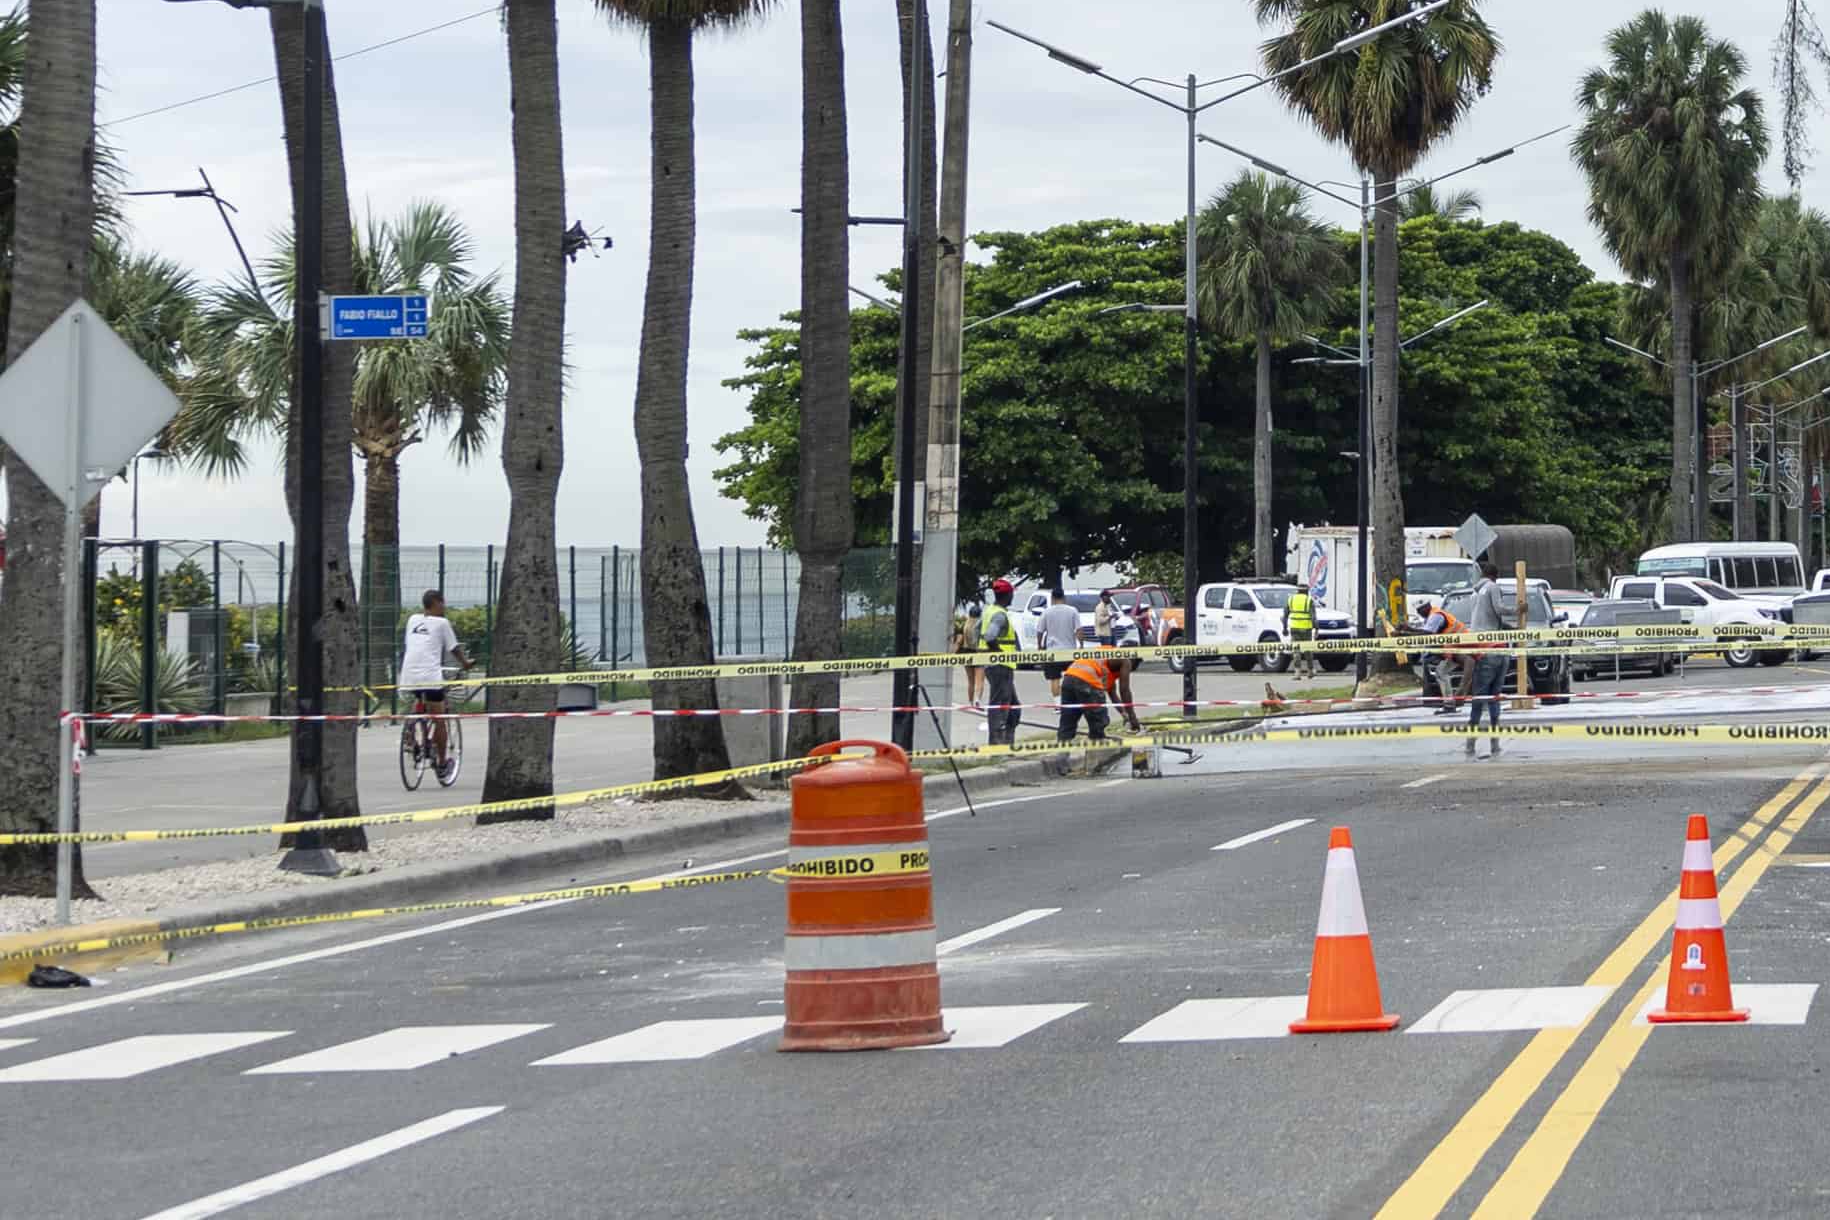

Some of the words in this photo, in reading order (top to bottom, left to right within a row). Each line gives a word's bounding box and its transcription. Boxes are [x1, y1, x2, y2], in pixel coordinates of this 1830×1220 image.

[339, 309, 365, 321] FABIO
[367, 308, 398, 321] FIALLO
[907, 657, 974, 667] PROHIBIDO
[989, 653, 1055, 664] PROHIBIDO
[1317, 639, 1381, 649] PROHIBIDO
[1396, 635, 1461, 646] PROHIBIDO
[1477, 631, 1541, 641] PROHIBIDO
[1556, 629, 1620, 639] PROHIBIDO
[1635, 627, 1699, 637] PROHIBIDO
[1713, 626, 1776, 636] PROHIBIDO
